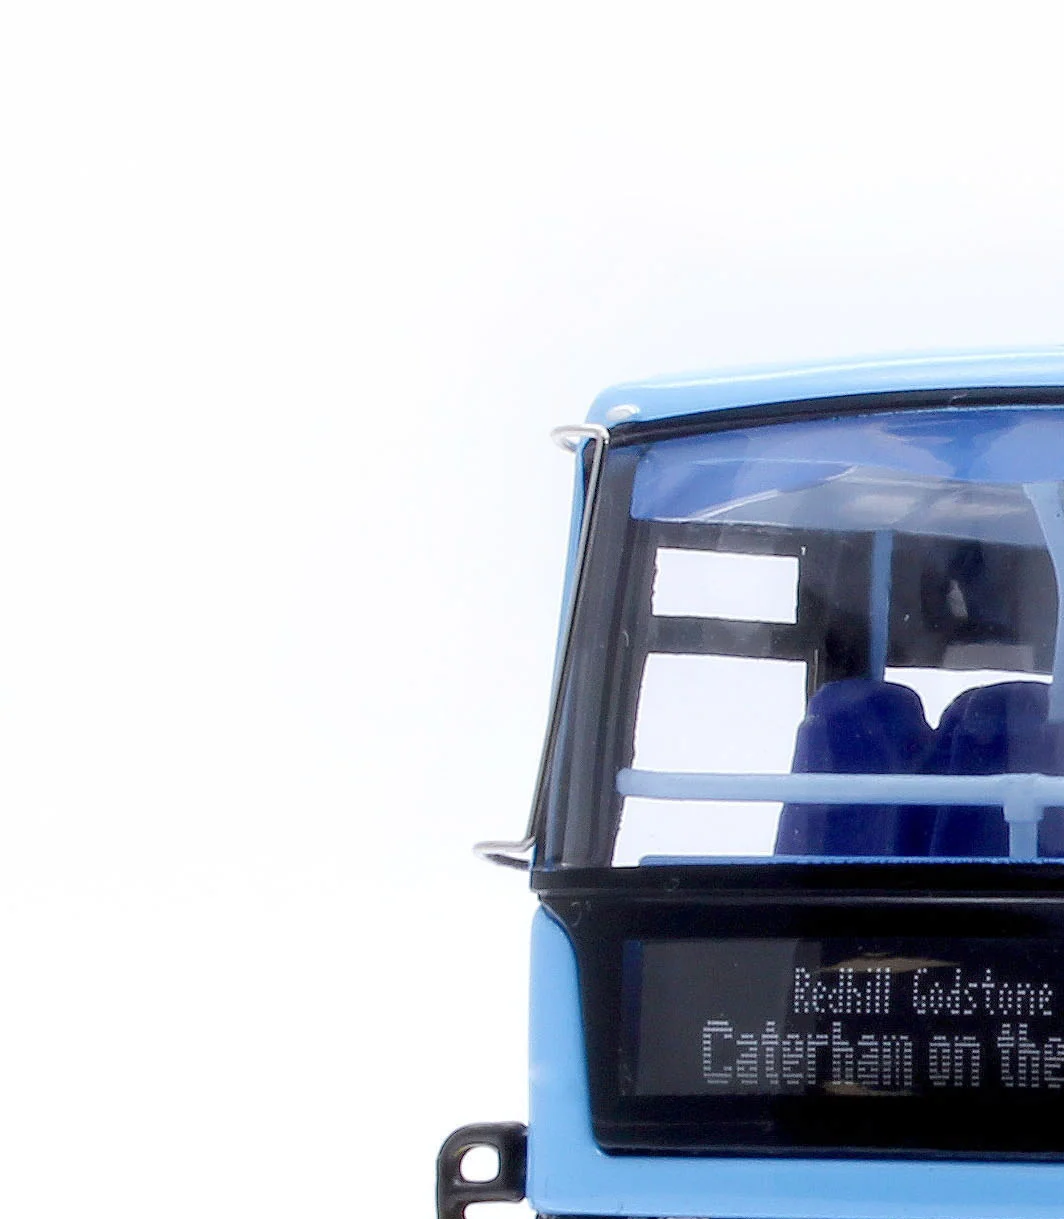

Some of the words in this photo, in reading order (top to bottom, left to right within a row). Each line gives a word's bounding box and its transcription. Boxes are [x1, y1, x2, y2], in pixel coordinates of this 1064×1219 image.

[795, 967, 891, 1014] Redhill
[913, 968, 1053, 1015] Godstone
[702, 1020, 913, 1085] Caterham
[928, 1034, 980, 1087] on
